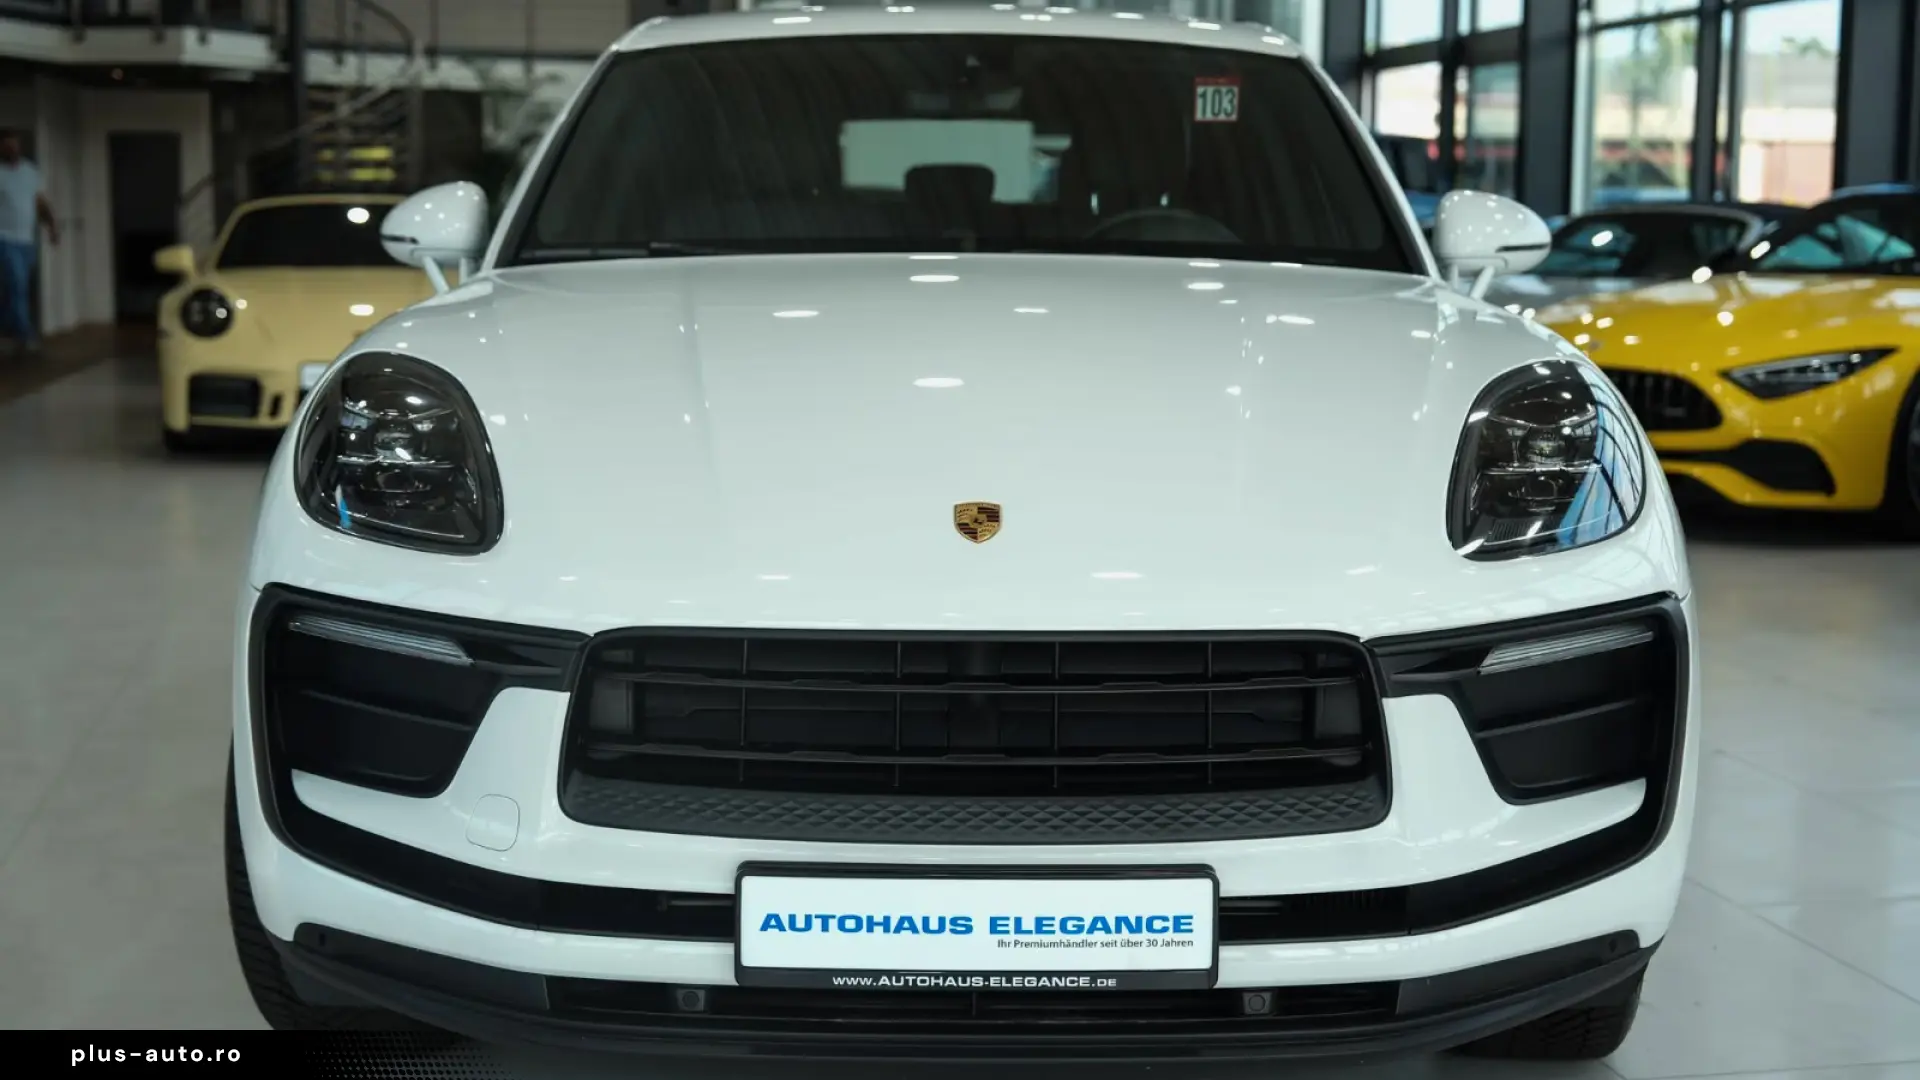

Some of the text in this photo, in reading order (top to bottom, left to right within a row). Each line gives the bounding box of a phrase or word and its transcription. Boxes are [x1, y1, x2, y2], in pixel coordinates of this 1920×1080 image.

[1198, 88, 1236, 118] 103
[759, 913, 1194, 935] AUTOHAUS ELEGANCE
[997, 937, 1194, 949] Ihr Premiumhändler seit über 30 Jahren
